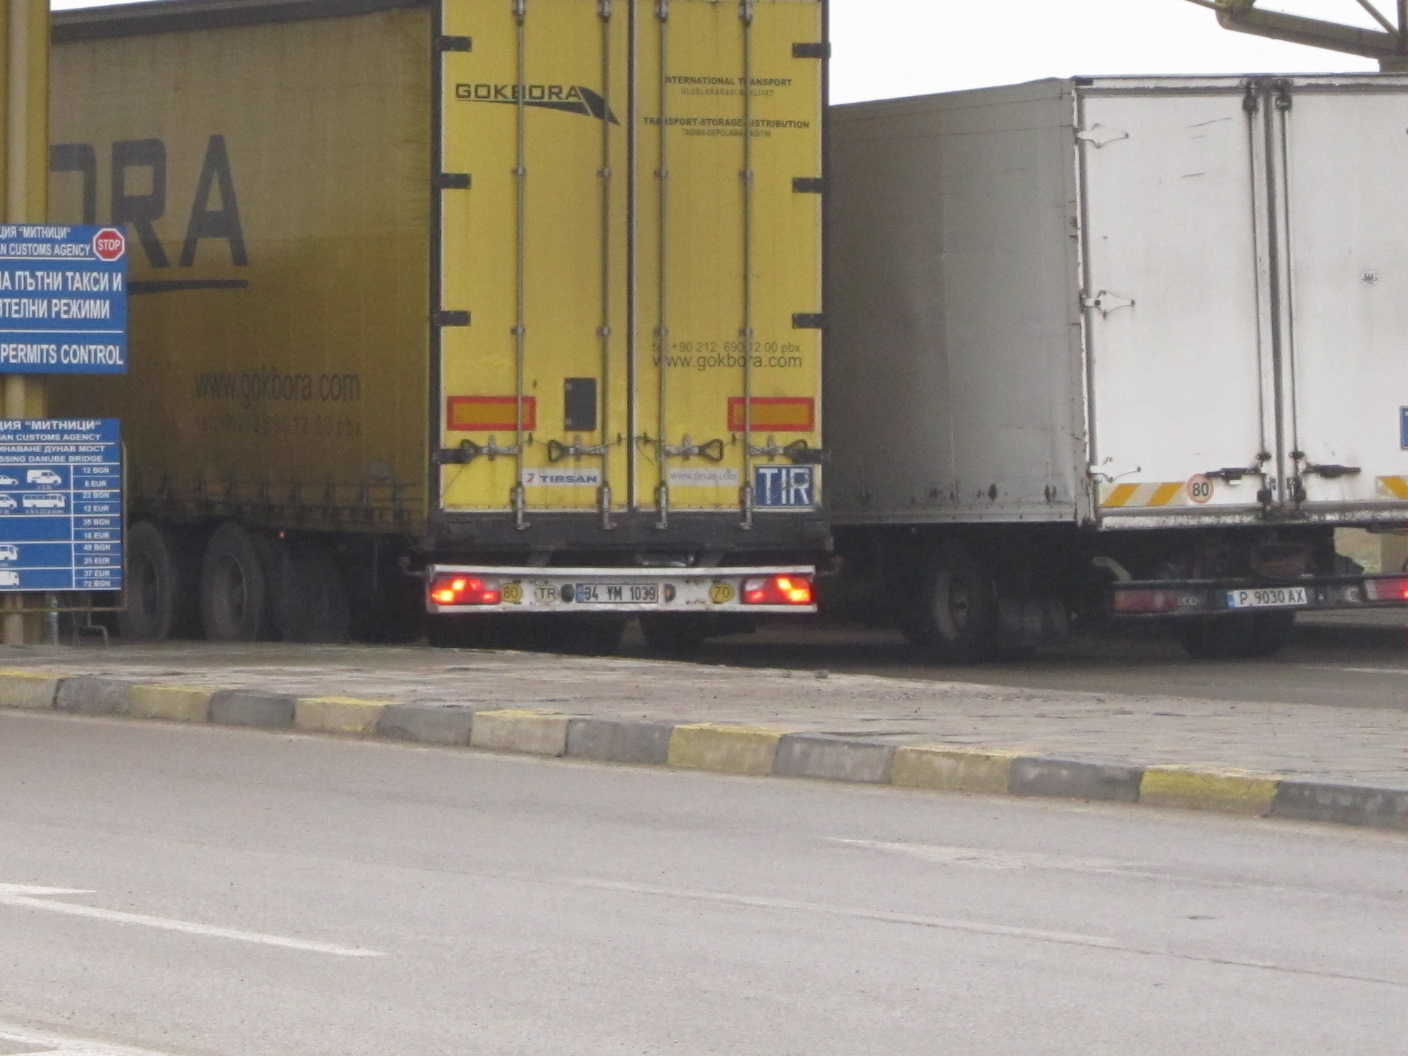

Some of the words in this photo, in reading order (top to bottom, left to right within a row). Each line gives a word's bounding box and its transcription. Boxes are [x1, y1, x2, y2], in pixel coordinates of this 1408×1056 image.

[664, 75, 735, 86] NTERNATIONAL
[738, 77, 792, 87] TANSPORT
[98, 238, 121, 251] STOP
[10, 244, 52, 256] CUSTOMS
[54, 244, 91, 256] AGENCY
[15, 271, 63, 291] ПЪТНИ
[66, 271, 109, 292] ТАКСИ
[112, 272, 122, 292] И
[52, 299, 110, 319] РЕЖИМИ
[0, 344, 57, 364] PERMITS
[61, 345, 124, 365] CONTROL
[16, 434, 61, 442] CUSTOMS
[63, 434, 101, 442] AGENCY
[44, 445, 77, 454] ДУНАВ
[78, 445, 105, 453] МОСТ
[28, 455, 66, 463] DANUBE
[68, 455, 104, 463] BRIDGE
[92, 466, 110, 474] BGN
[91, 480, 107, 488] EUR
[539, 475, 598, 483] TIRSAN
[758, 467, 810, 505] TIR
[1192, 482, 1208, 497] 80
[92, 491, 110, 499] BGN
[93, 505, 109, 513] EUR
[93, 518, 110, 526] BGN
[94, 557, 111, 565] EUR
[94, 569, 111, 577] EUR
[94, 580, 111, 588] BGN
[503, 586, 519, 599] 80
[539, 587, 557, 600] TR
[714, 586, 729, 599] 70
[1239, 591, 1248, 606] P
[1254, 590, 1286, 604] 9030
[1288, 589, 1303, 604] AX
